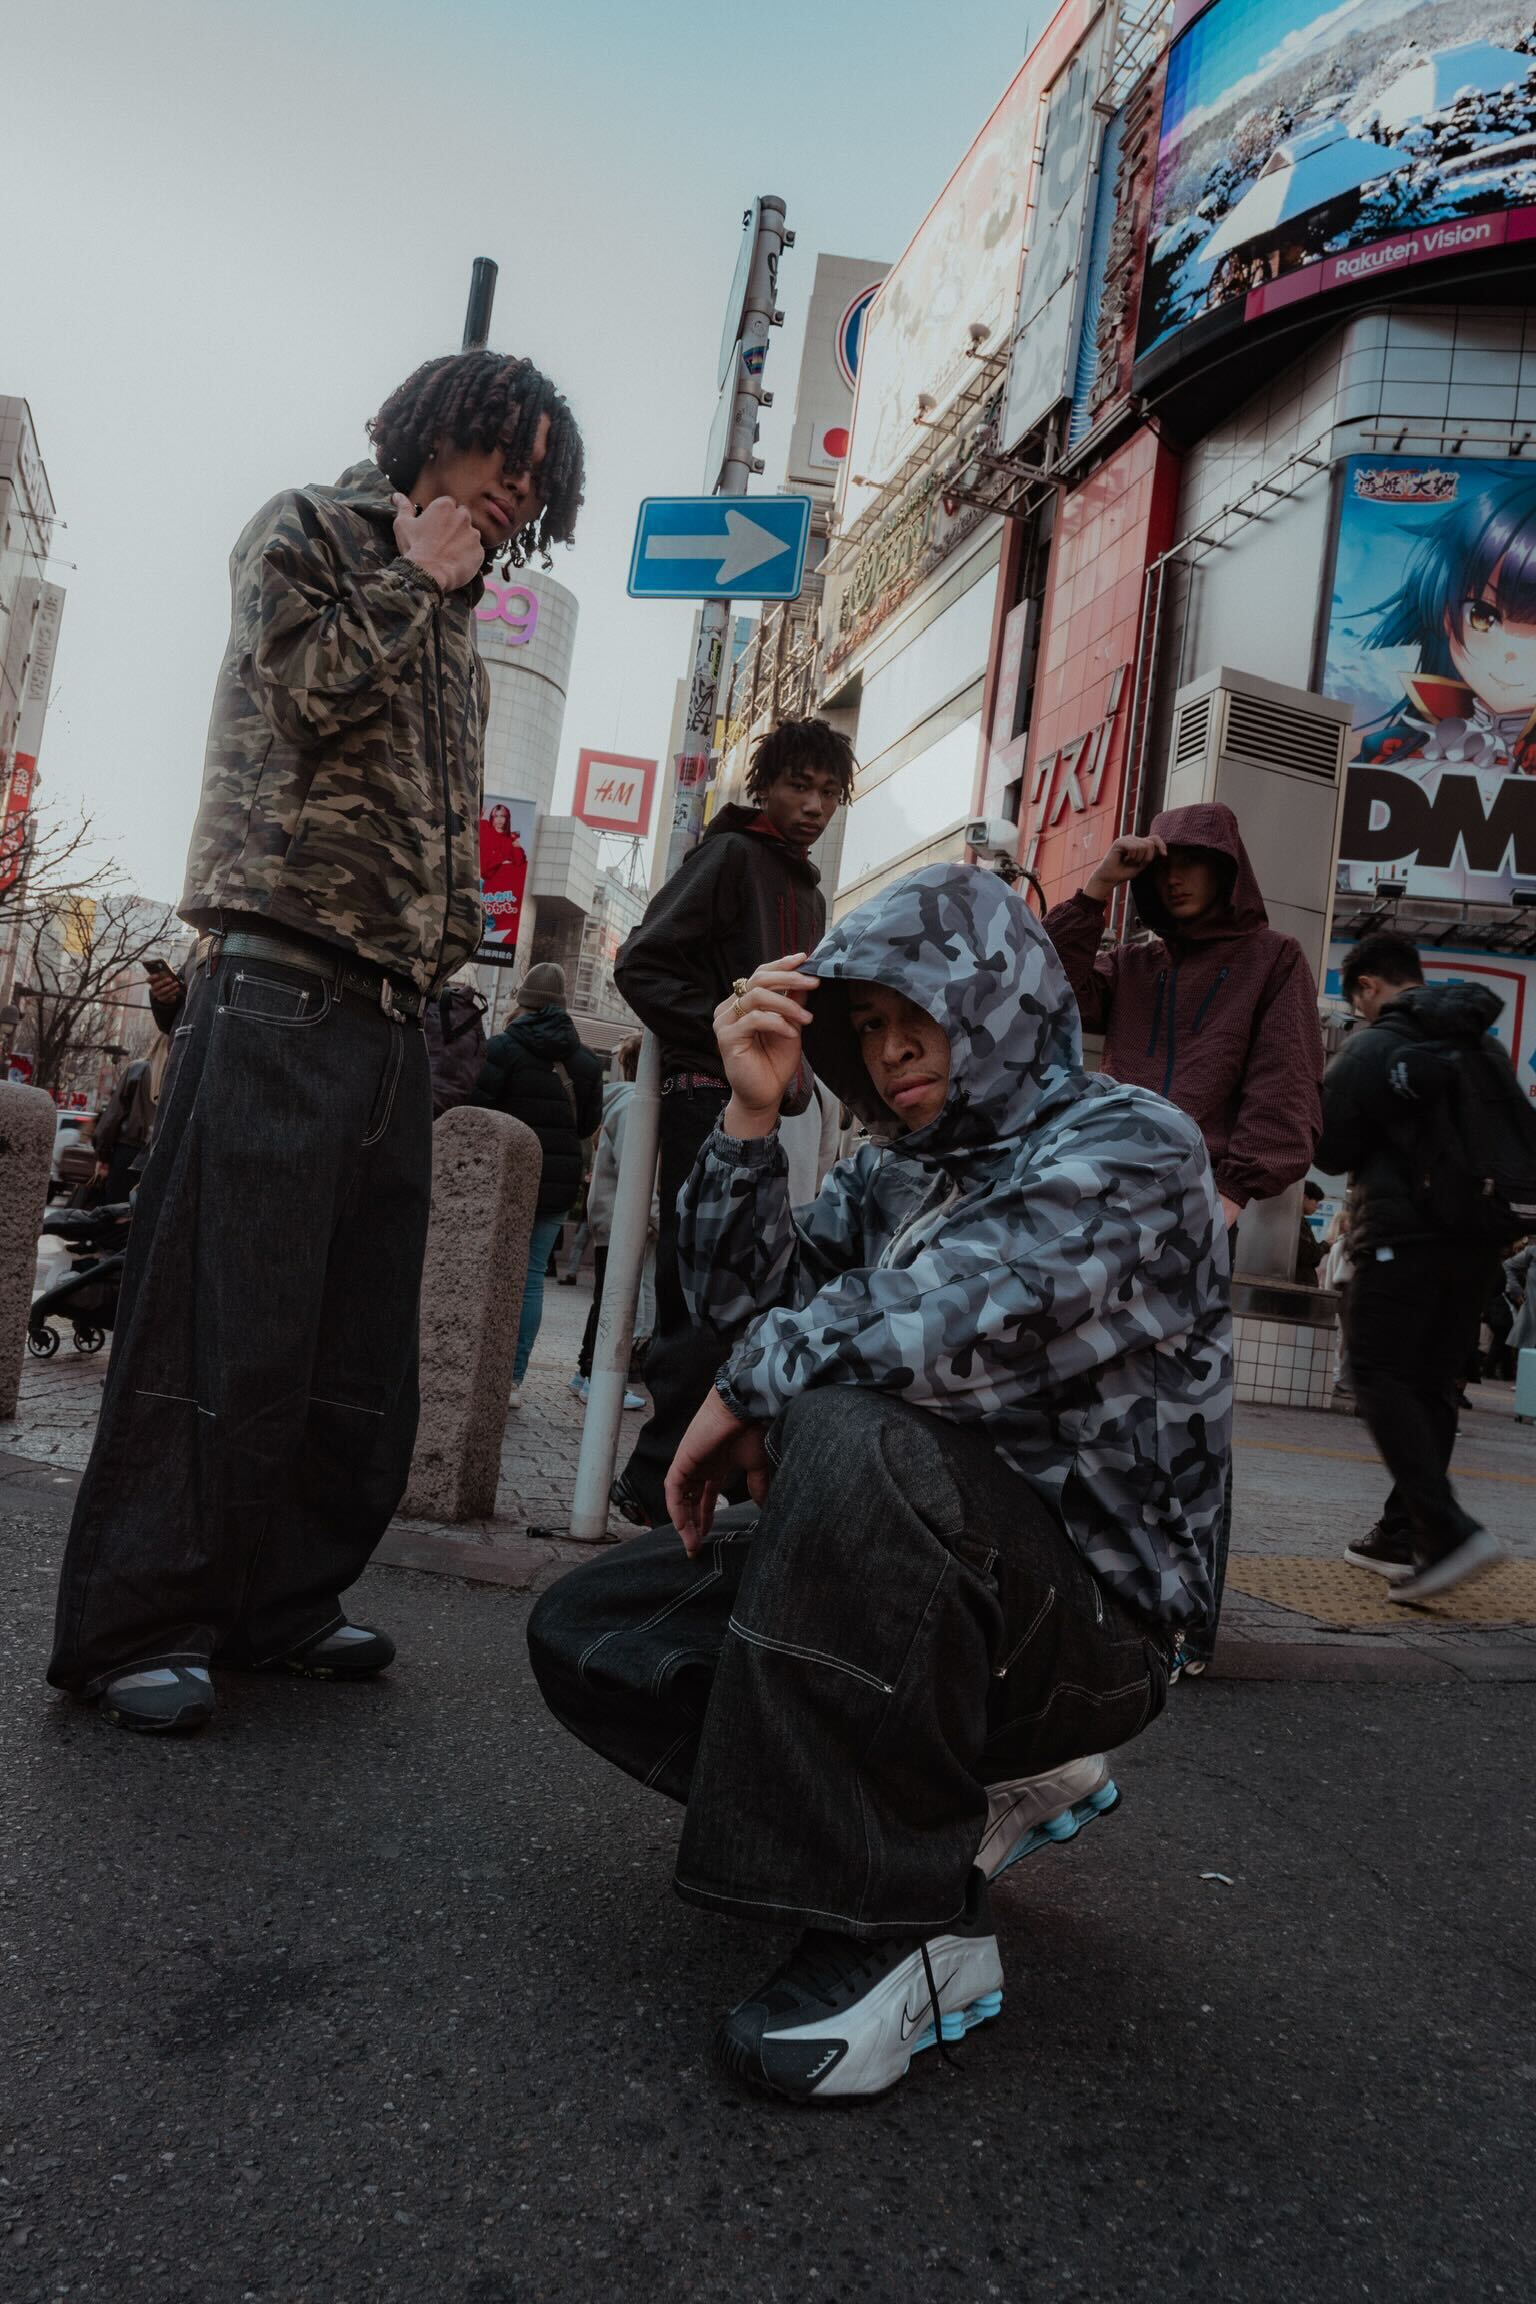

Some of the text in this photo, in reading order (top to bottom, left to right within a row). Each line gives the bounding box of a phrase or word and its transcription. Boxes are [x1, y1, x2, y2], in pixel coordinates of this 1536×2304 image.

[1335, 223, 1490, 278] Rakuten Vision
[28, 597, 58, 700] BIC CAMERA
[594, 778, 635, 806] H&M
